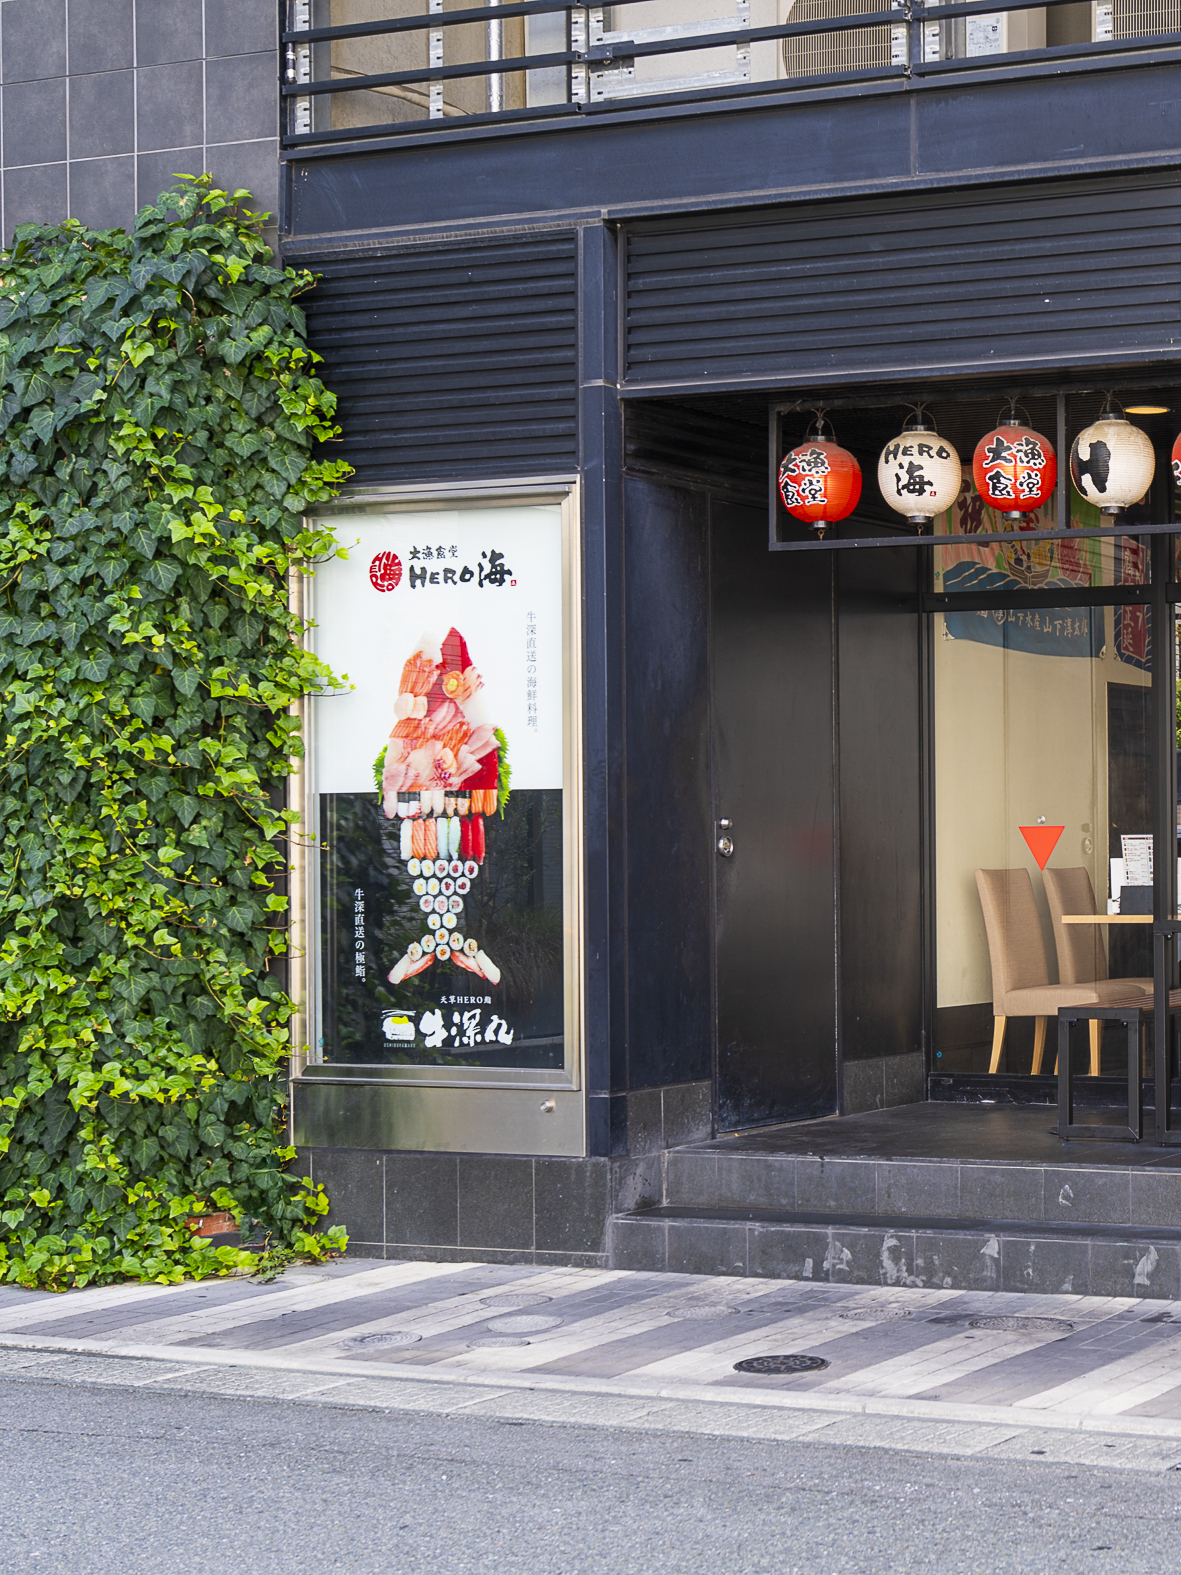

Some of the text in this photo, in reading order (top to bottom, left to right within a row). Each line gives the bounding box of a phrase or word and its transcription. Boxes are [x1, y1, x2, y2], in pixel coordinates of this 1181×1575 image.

[885, 442, 951, 464] HERO
[895, 460, 934, 497] 海
[408, 545, 458, 561] 大漁食堂
